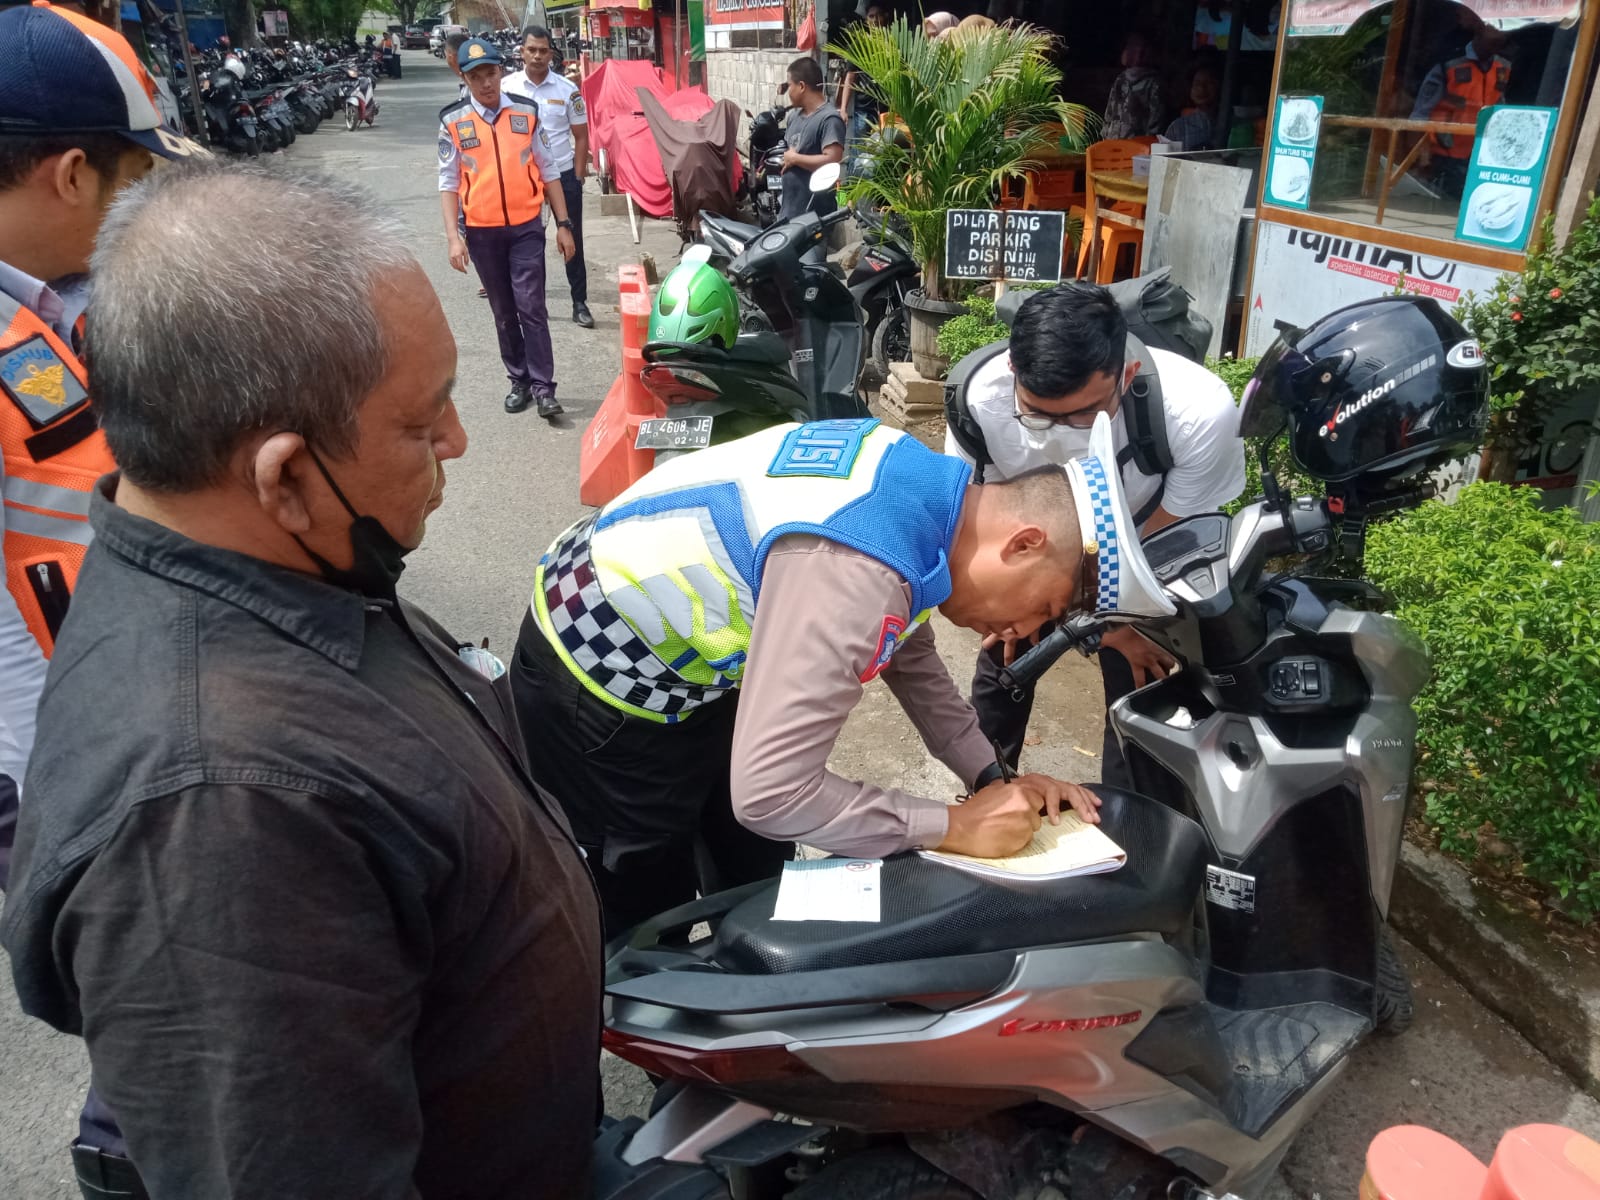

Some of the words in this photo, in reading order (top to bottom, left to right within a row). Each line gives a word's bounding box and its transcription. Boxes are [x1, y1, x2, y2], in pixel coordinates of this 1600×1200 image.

[953, 213, 1041, 232] DILARANG
[969, 230, 1032, 249] PARKIR
[1330, 258, 1363, 276] specialist
[1363, 267, 1390, 283] interior
[1431, 286, 1457, 299] panel
[1, 348, 54, 381] DISHUB
[640, 422, 653, 435] BL
[659, 420, 687, 434] 4608
[694, 419, 710, 432] JE
